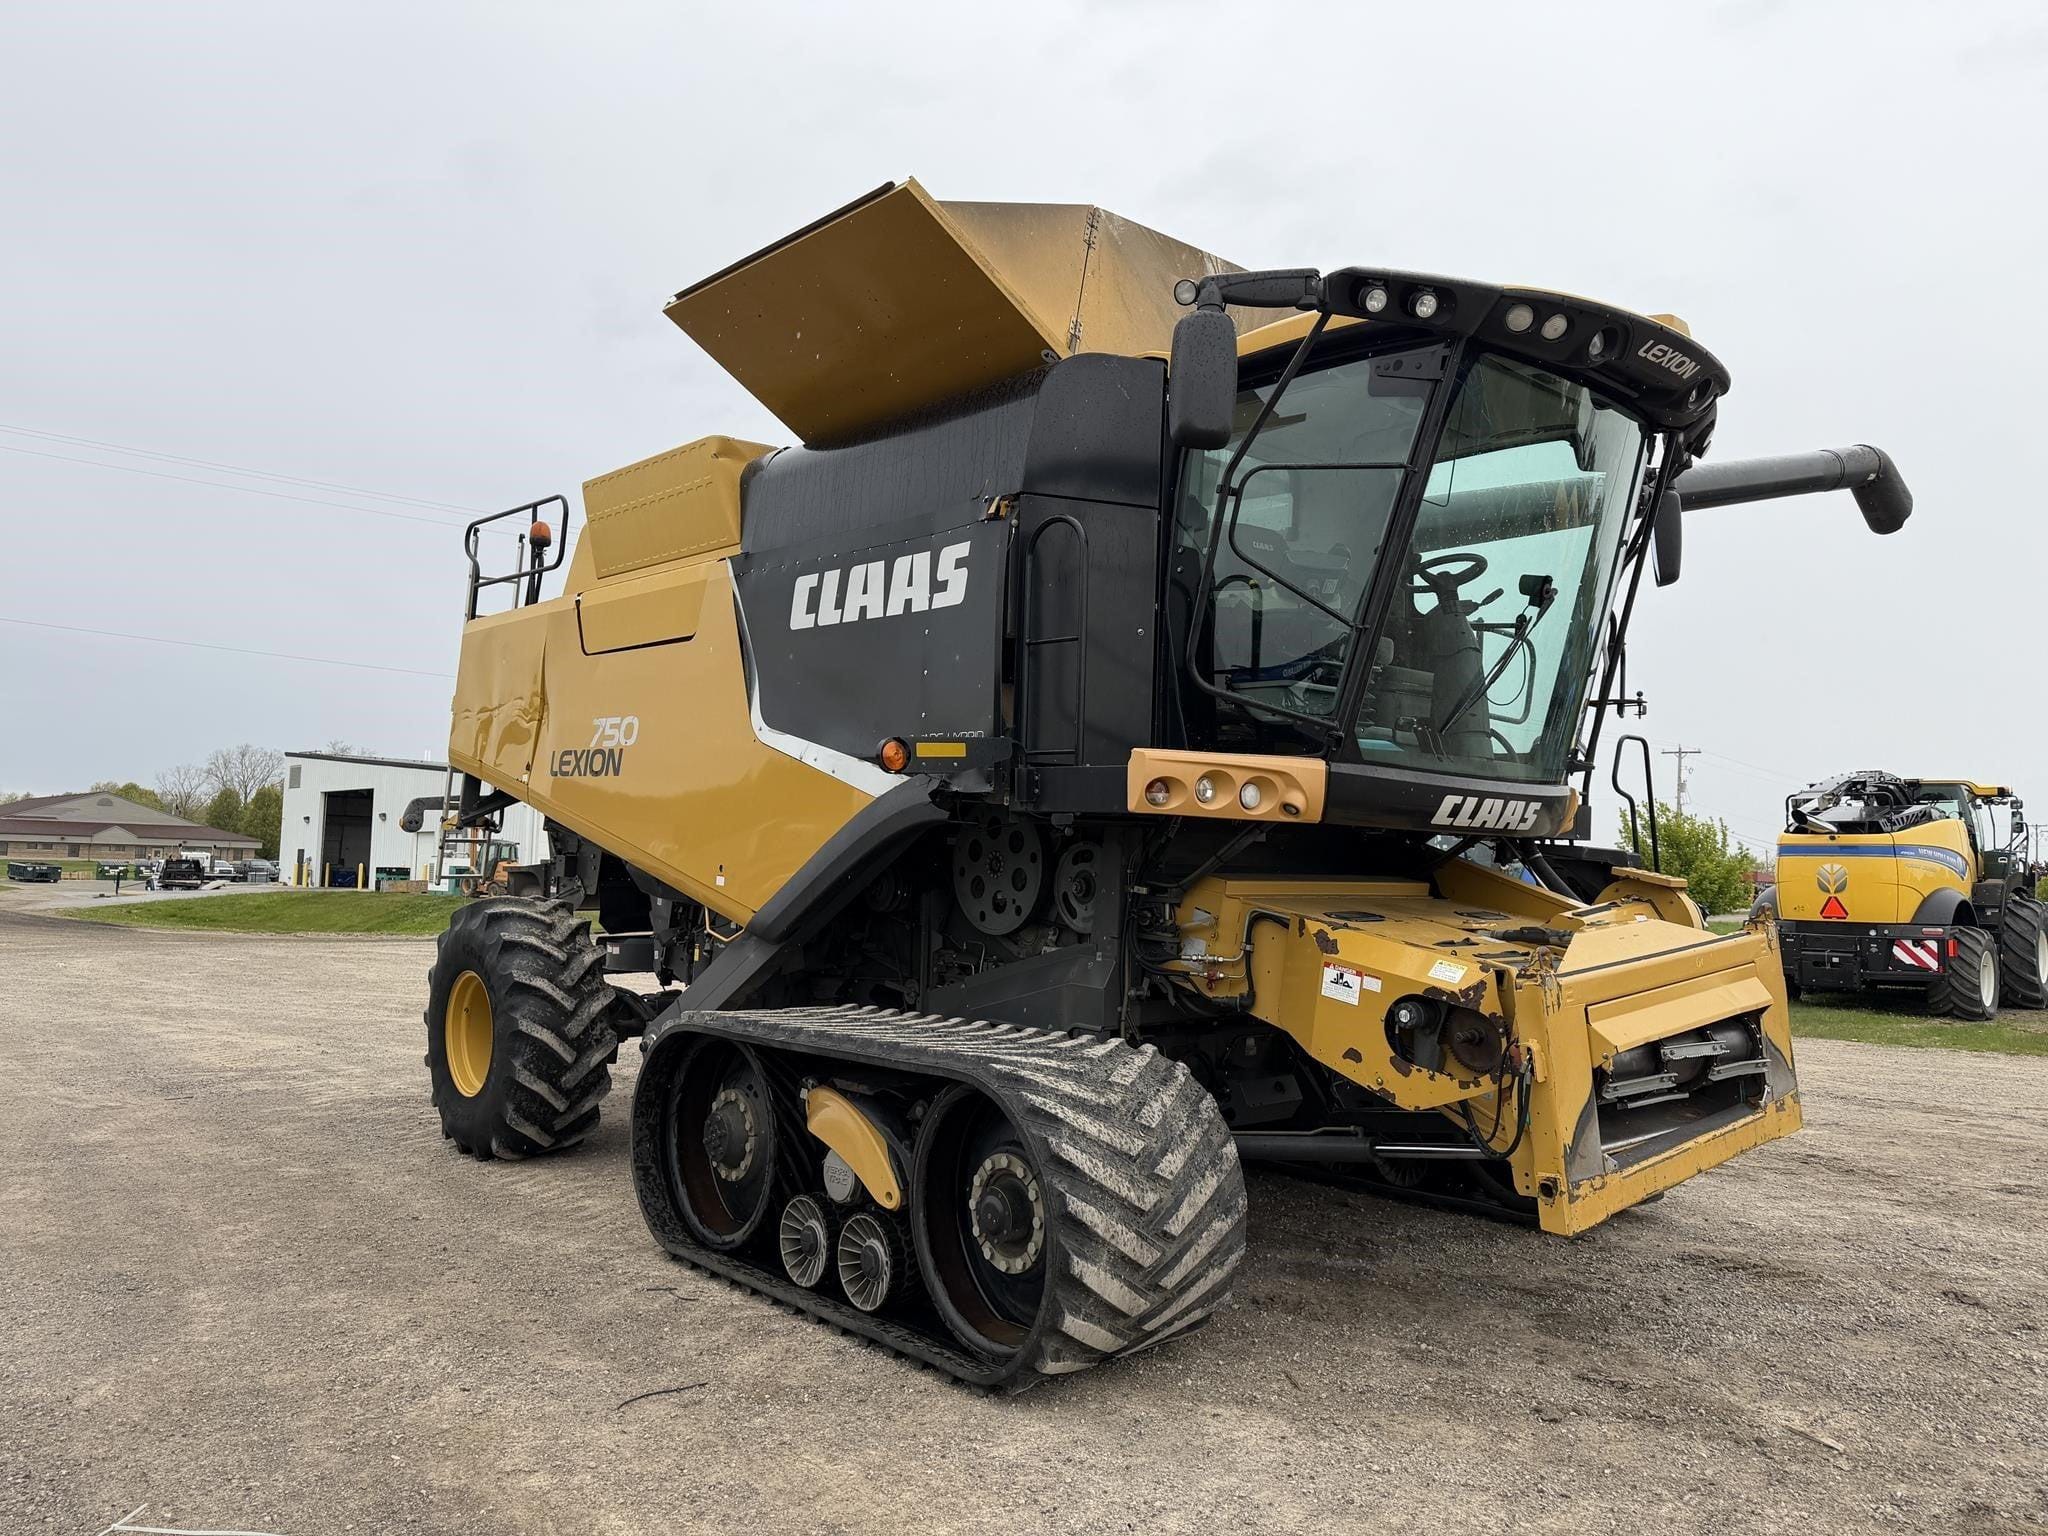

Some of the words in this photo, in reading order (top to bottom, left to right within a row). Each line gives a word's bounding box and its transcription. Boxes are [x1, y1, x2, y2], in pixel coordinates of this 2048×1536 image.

[1637, 339, 1700, 379] LEXION
[789, 540, 971, 631] CLAAS
[589, 715, 639, 748] 750
[549, 747, 623, 778] LEXION
[1430, 795, 1543, 831] CLAAS
[1335, 964, 1357, 975] DANGER
